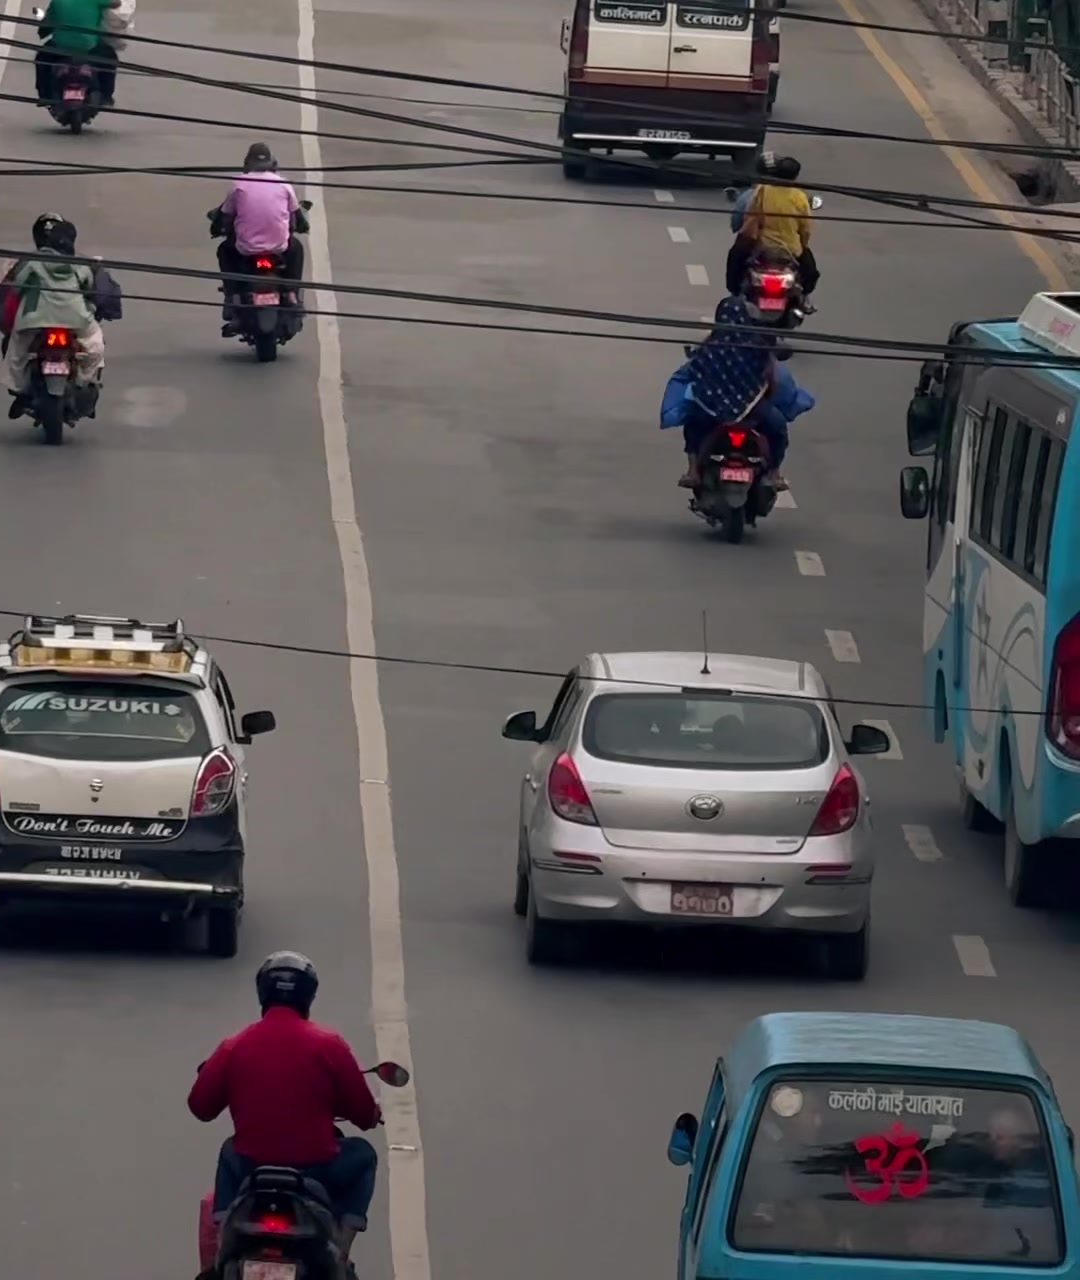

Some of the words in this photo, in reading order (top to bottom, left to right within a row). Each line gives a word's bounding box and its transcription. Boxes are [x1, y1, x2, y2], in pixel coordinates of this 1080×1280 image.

[47, 696, 160, 715] SUZUKI
[13, 815, 68, 832] Don't
[75, 818, 134, 835] Touch
[140, 821, 174, 838] Me
[828, 1087, 876, 1112] कलंकी
[905, 1095, 964, 1117] यातायात
